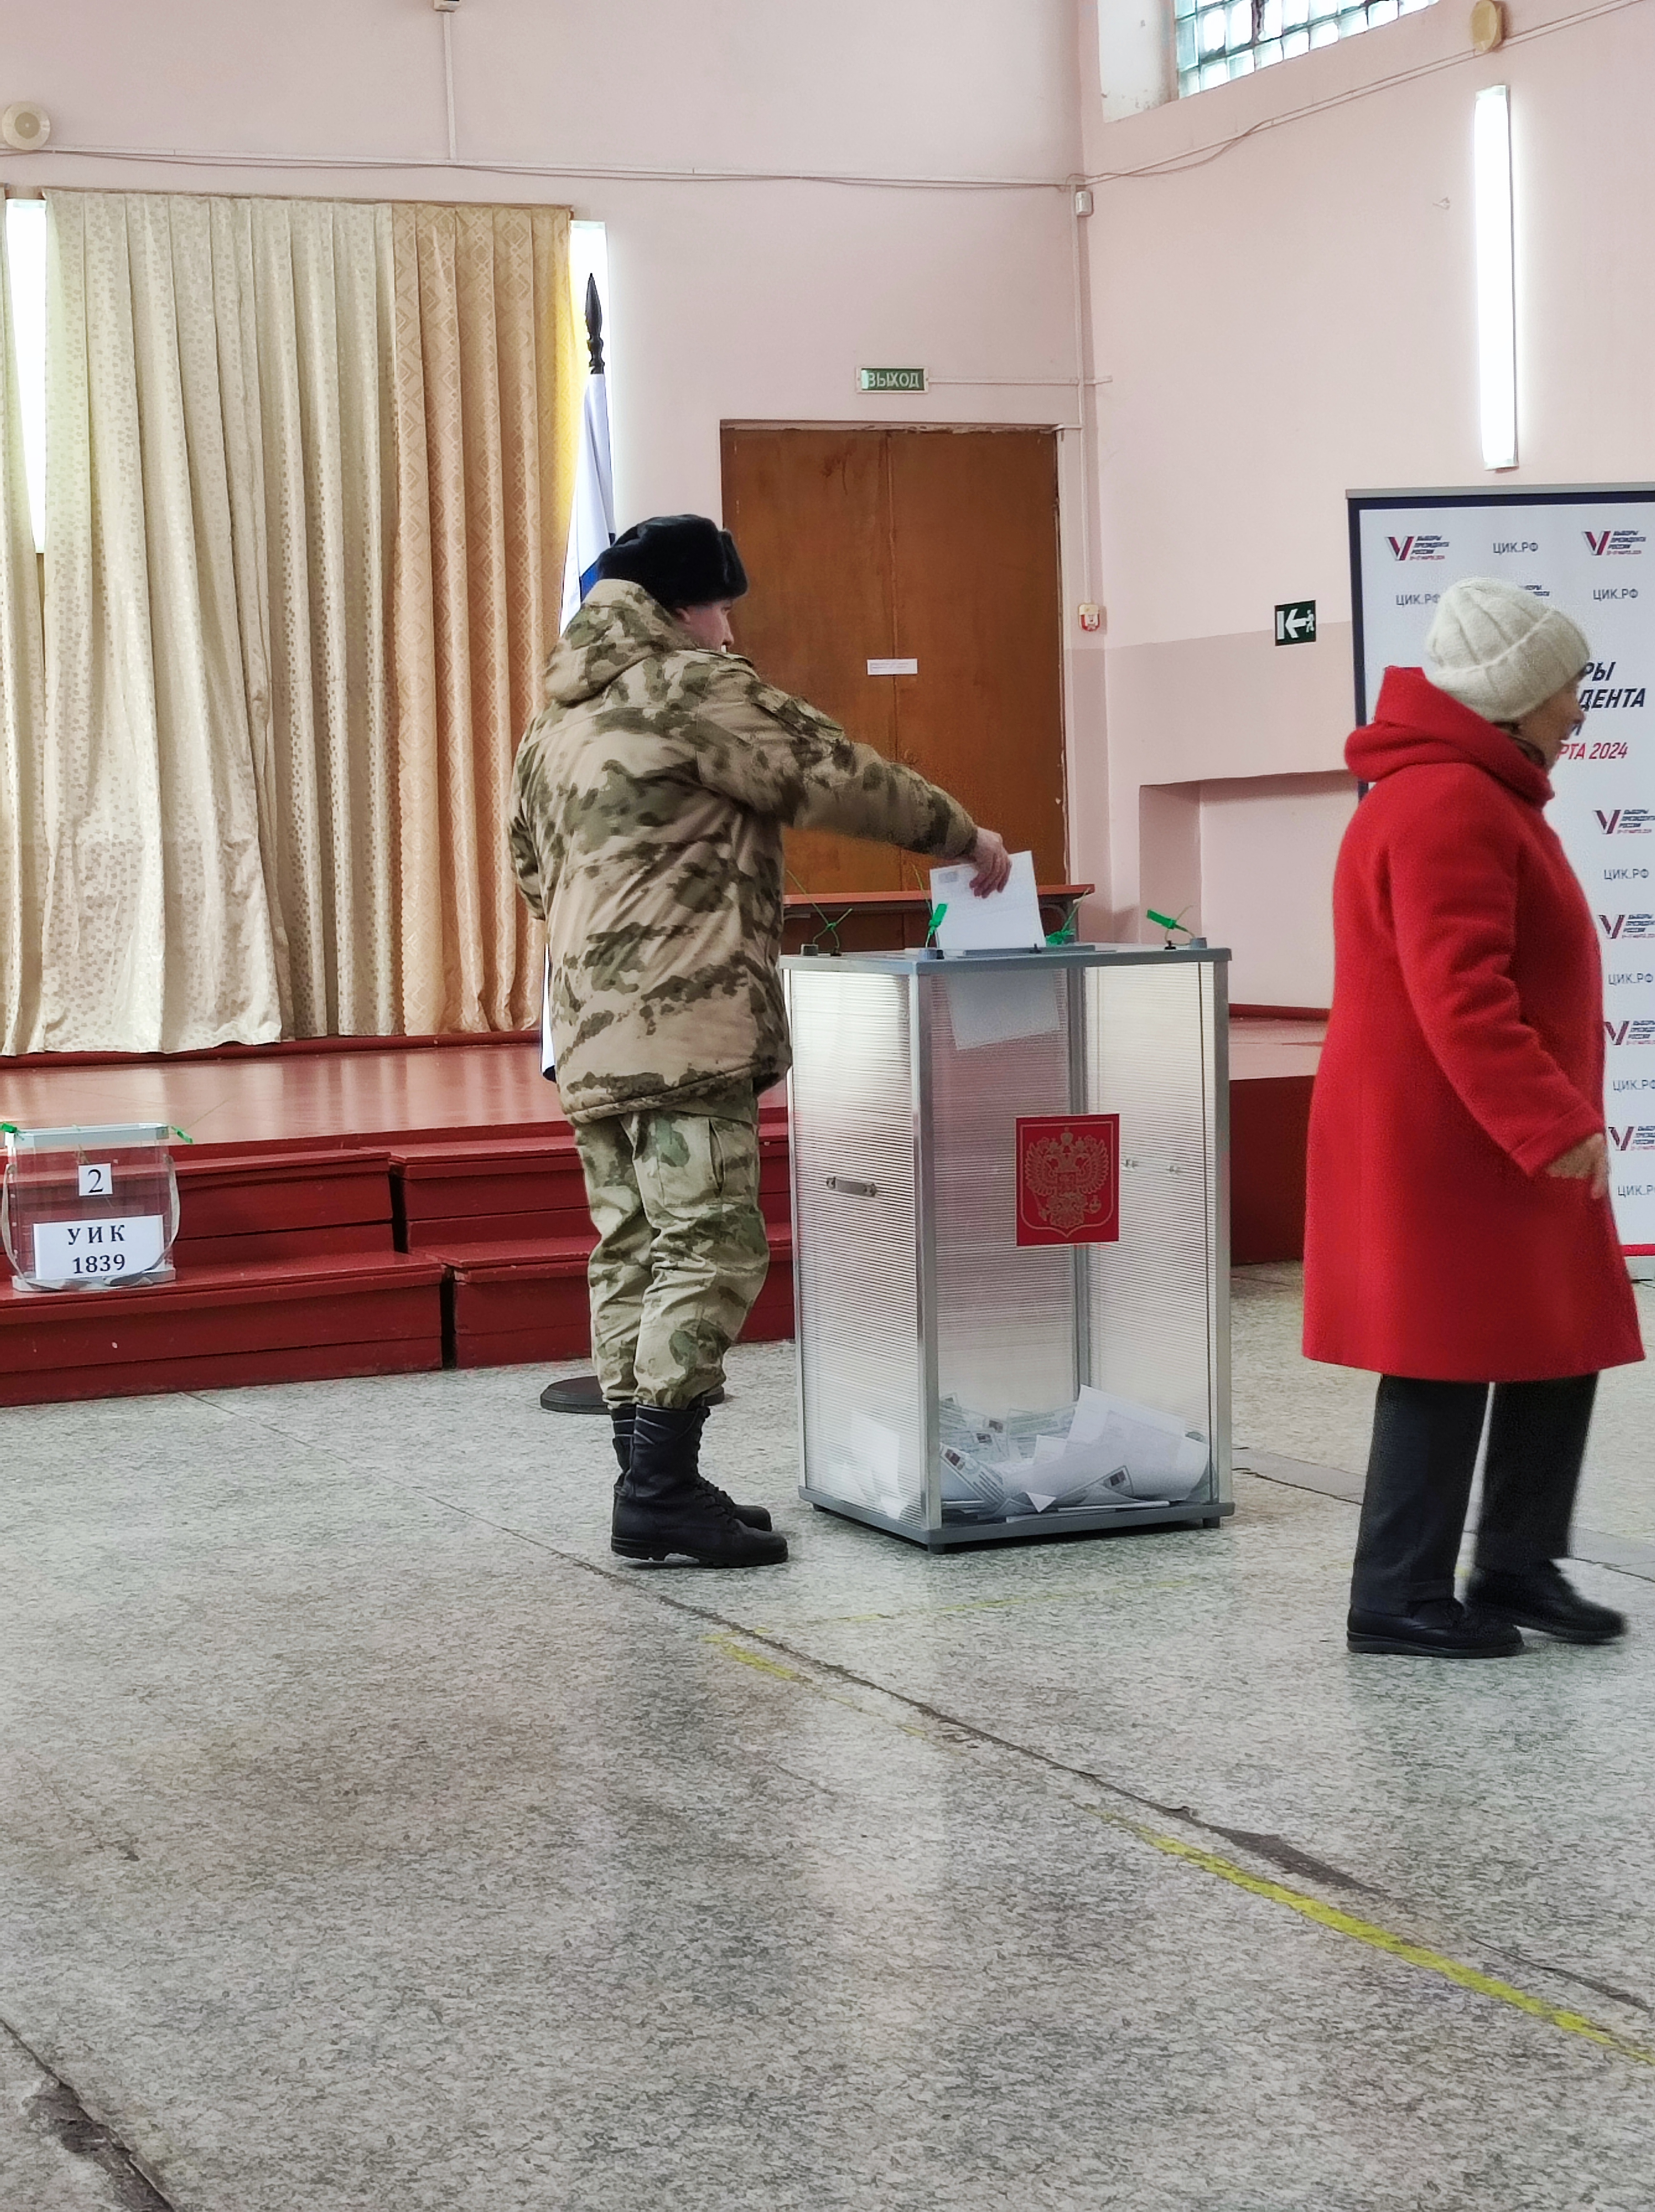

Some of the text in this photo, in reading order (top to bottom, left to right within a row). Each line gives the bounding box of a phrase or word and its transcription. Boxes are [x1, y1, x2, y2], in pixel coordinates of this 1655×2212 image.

[867, 372, 920, 389] ВЫХОД
[1492, 542, 1539, 555] ЦИК.РФ
[1593, 588, 1639, 602] ЦИК.РФ
[1578, 688, 1646, 712] ДЕНТА
[1556, 742, 1629, 760] РТА 2024
[1604, 869, 1649, 881] ЦИК.РФ
[1608, 973, 1654, 985] ЦИК.РФ
[87, 1168, 104, 1193] 2
[1617, 1185, 1655, 1197] ЦИК.Р
[72, 1253, 125, 1274] 1839
